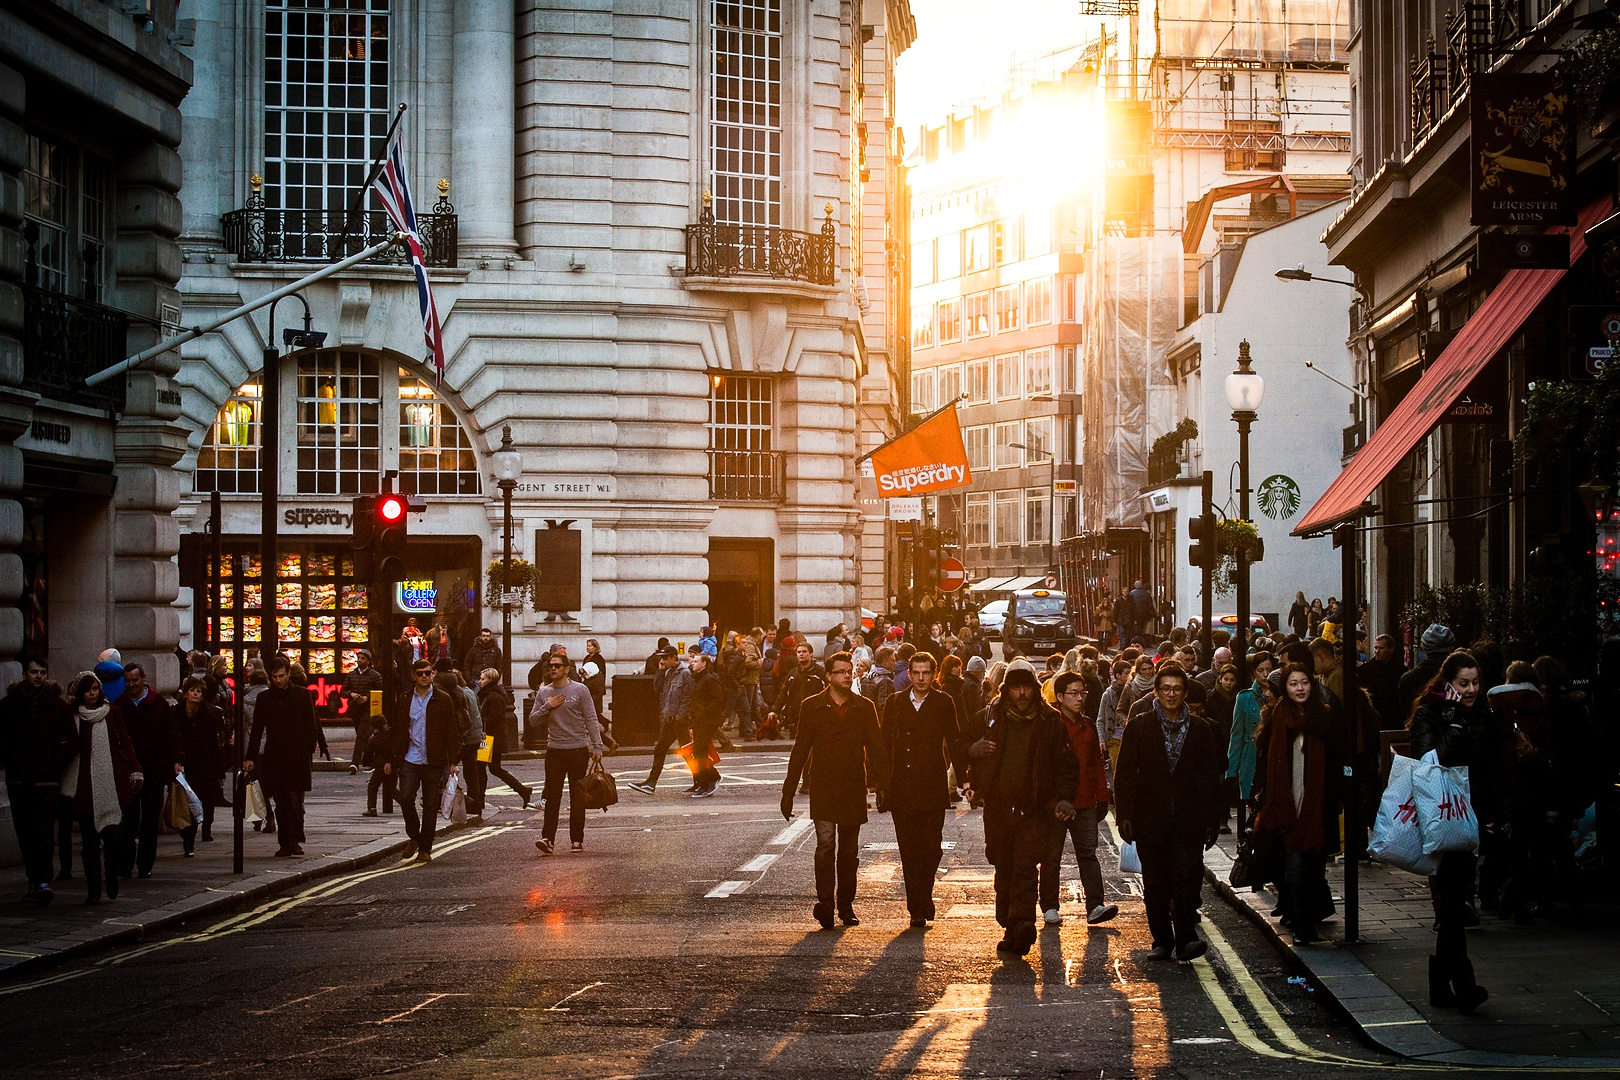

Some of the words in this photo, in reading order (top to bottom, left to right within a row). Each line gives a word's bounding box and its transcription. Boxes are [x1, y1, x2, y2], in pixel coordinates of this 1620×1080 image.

[1492, 201, 1558, 210] LEICESTER
[1508, 212, 1543, 221] ARMS
[879, 463, 965, 492] Superdry
[554, 484, 591, 492] STREET
[284, 509, 354, 529] Superdry
[402, 580, 434, 590] T-SHIRT
[1437, 791, 1470, 823] H&M
